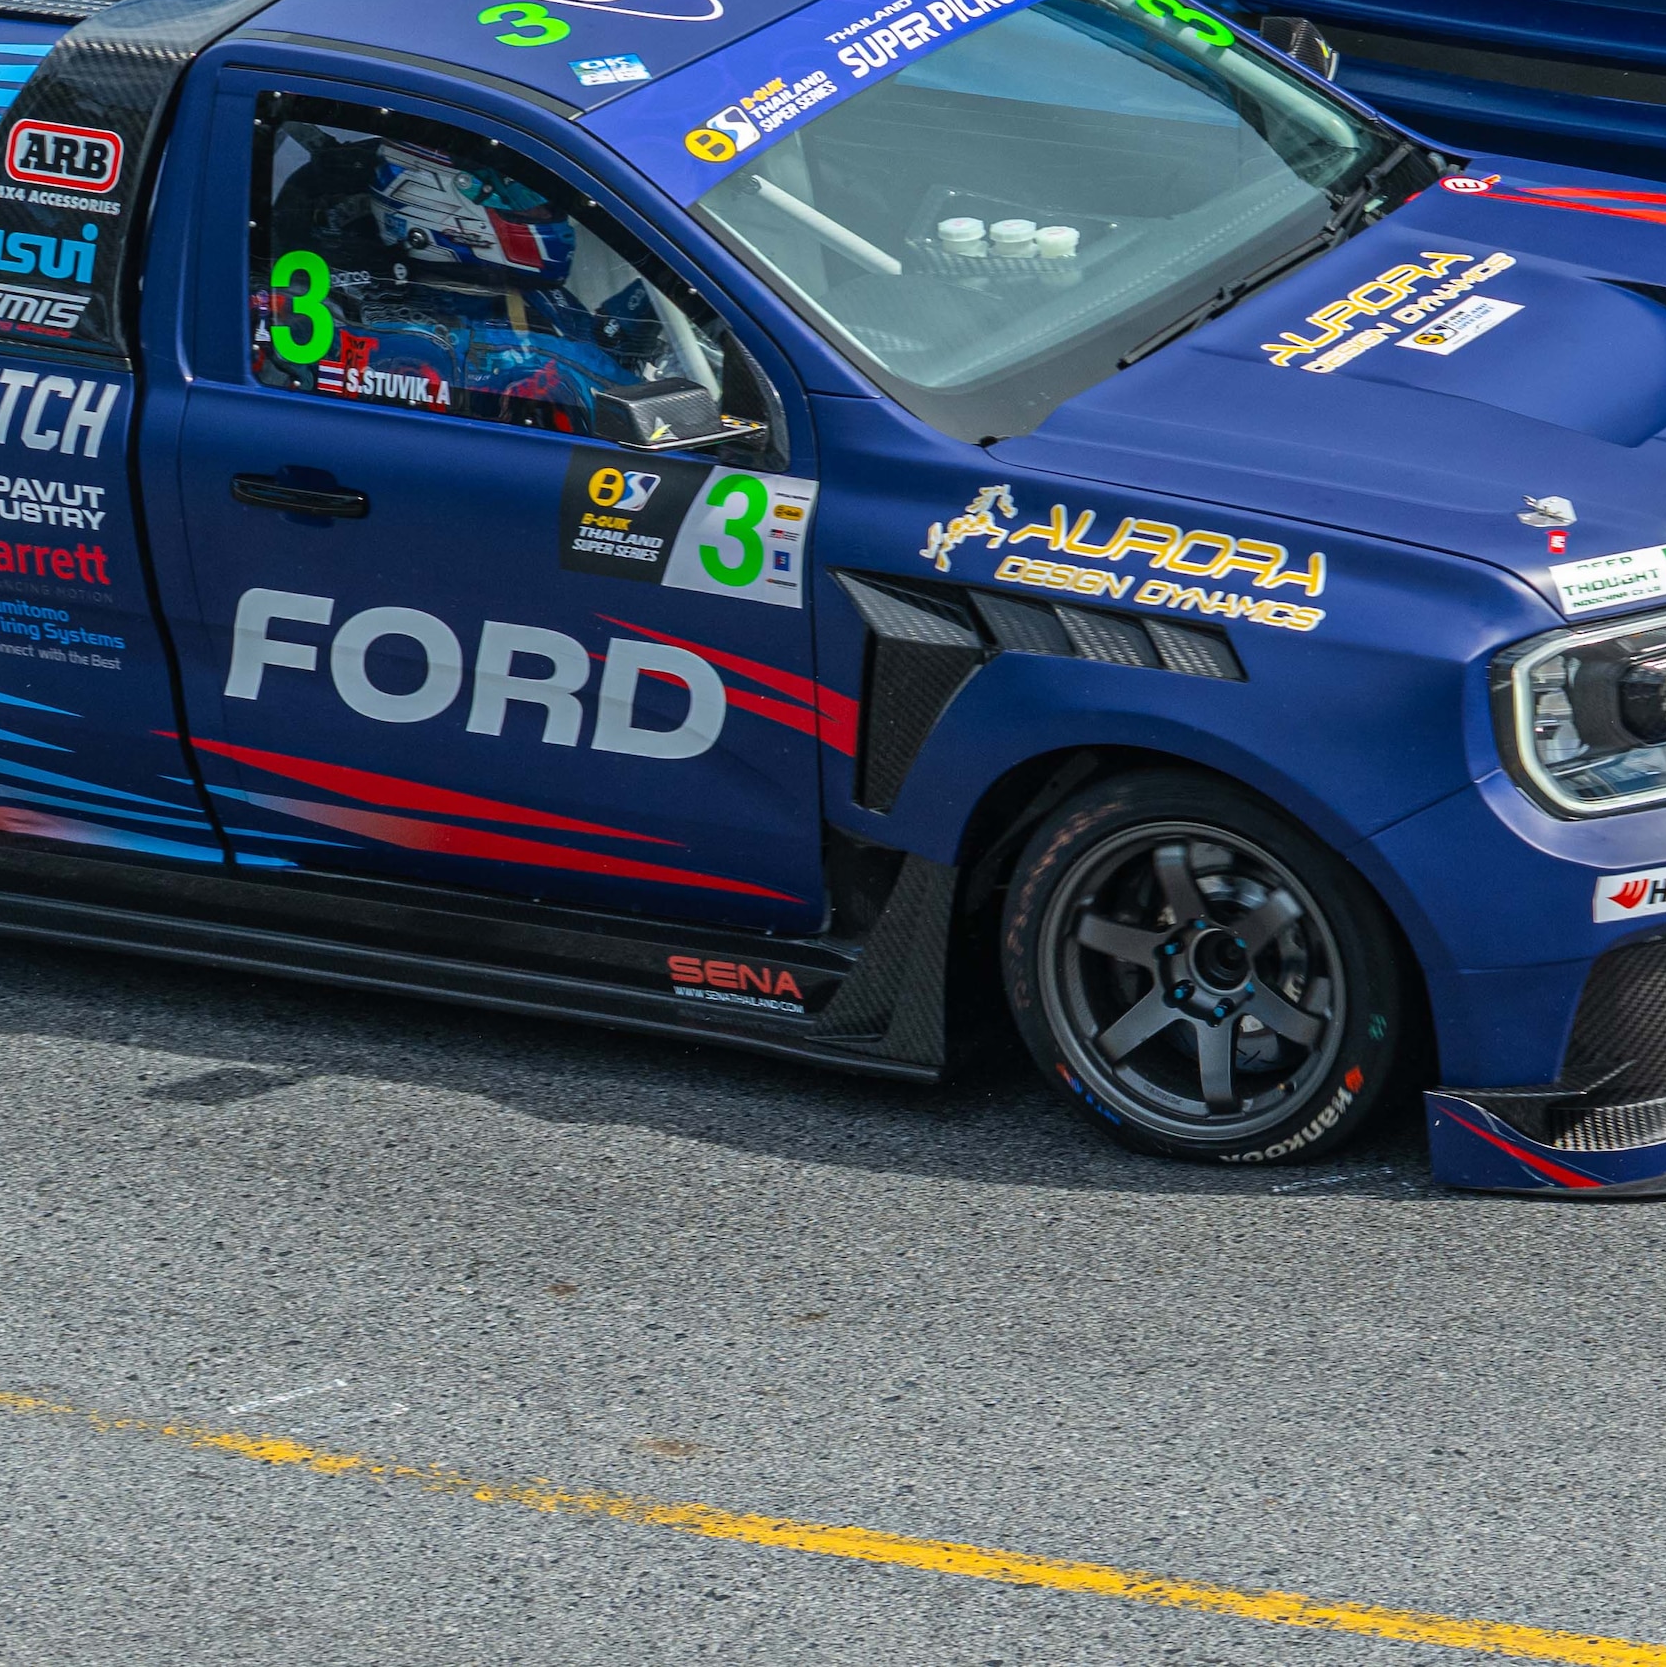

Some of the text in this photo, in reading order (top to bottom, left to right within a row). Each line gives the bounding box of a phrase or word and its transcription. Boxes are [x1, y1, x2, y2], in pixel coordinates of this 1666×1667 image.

[477, 1, 572, 47] 3
[837, 11, 941, 79] SUPER
[749, 70, 828, 120] THAILAND
[759, 80, 838, 133] SUPER SERIES
[19, 132, 109, 180] ARB
[28, 189, 121, 216] ACCESSORIES
[270, 250, 333, 365] 3
[1260, 251, 1475, 367] AURORA
[1300, 323, 1401, 374] DESIGN
[1391, 252, 1517, 325] DYNAMICS
[571, 537, 660, 563] SUPER SERIES
[578, 525, 664, 549] THAILAND
[699, 473, 769, 588] 3
[1008, 503, 1327, 597] AURORA
[994, 555, 1327, 632] DESIGN DYNAMICS
[1562, 568, 1660, 596] THOUGHT
[38, 647, 66, 662] with
[68, 650, 89, 666] the
[91, 654, 122, 670] Best
[43, 622, 126, 650] Systems
[225, 586, 726, 759] FORD
[666, 955, 803, 1000] SENA
